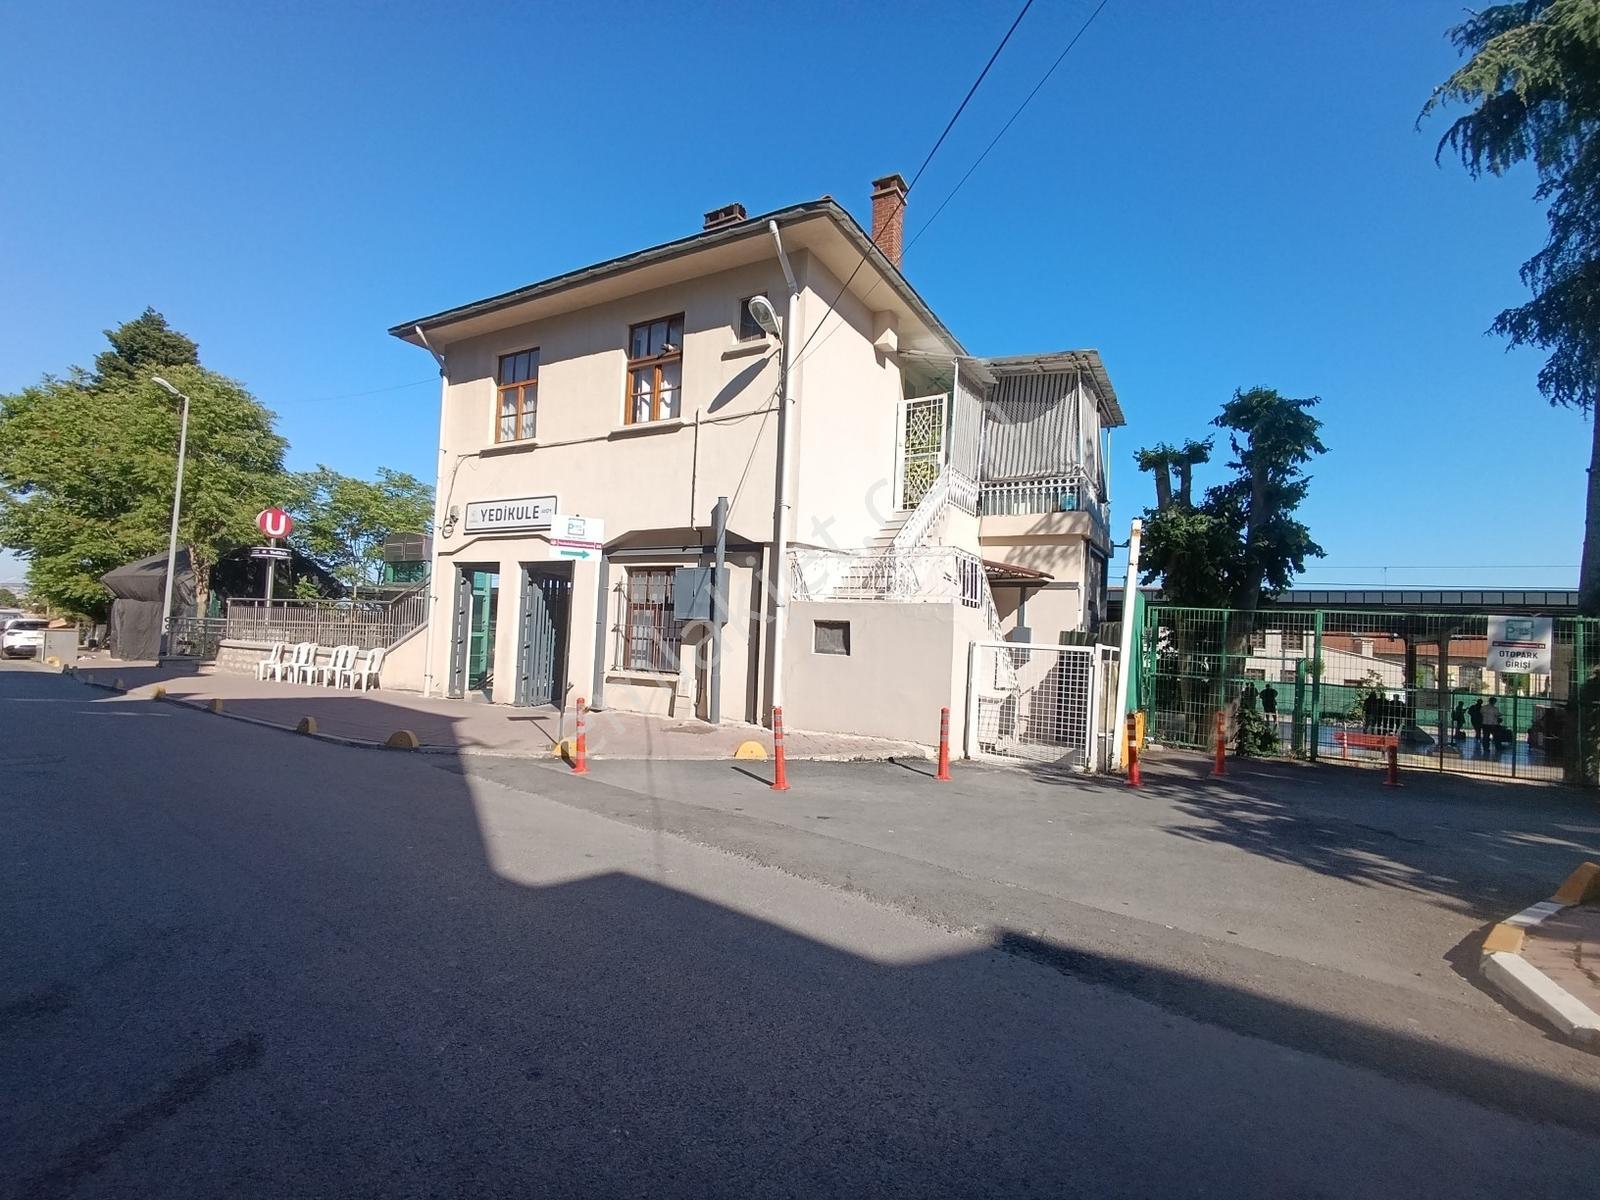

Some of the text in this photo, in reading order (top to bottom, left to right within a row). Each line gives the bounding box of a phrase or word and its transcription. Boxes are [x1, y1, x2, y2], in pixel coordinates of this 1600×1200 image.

[480, 505, 540, 522] YEDİKULE
[266, 512, 286, 535] U
[1499, 650, 1539, 659] OTOPARK
[1505, 660, 1531, 670] GİRİŞİ
